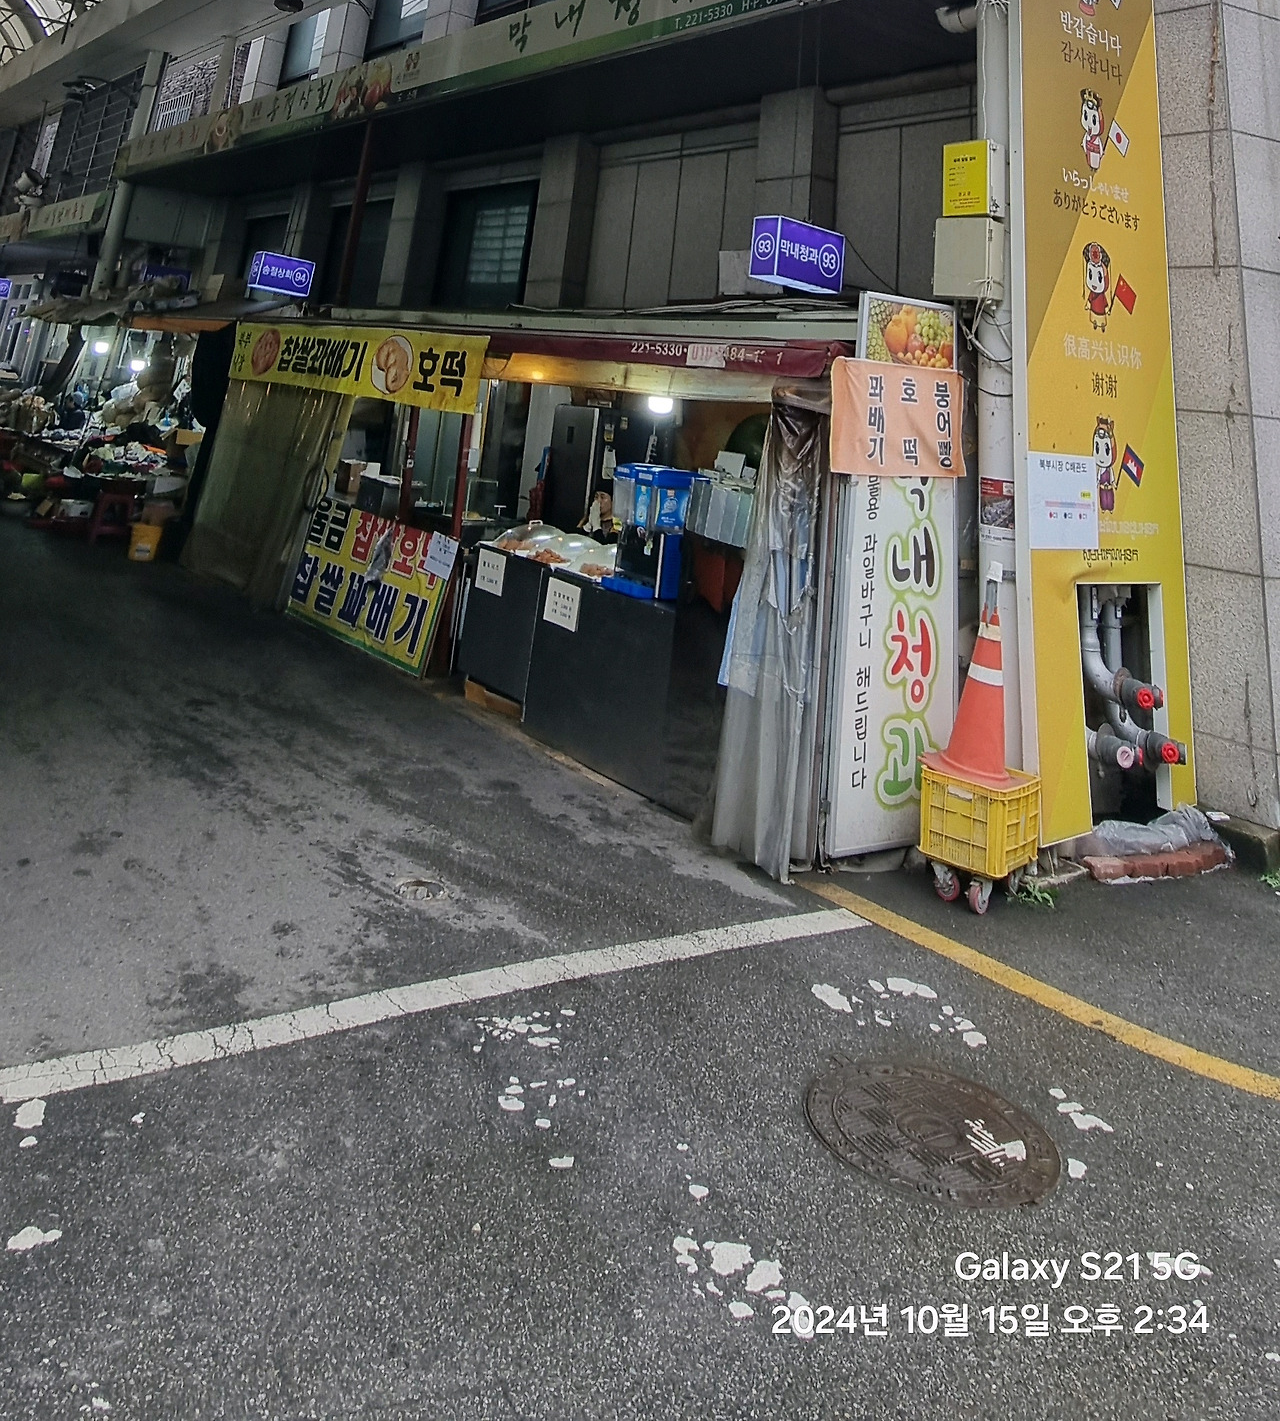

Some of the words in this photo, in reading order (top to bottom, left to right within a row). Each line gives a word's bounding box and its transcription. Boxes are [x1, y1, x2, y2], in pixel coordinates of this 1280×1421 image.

[686, 2, 733, 28] 221-5330
[1060, 10, 1121, 56] 반갑습니다
[1060, 40, 1122, 85] 감사합니다
[1062, 167, 1130, 204] いらっしゃいませ
[1053, 189, 1140, 232] ありがとうございます
[758, 240, 771, 253] 93
[781, 239, 818, 265] 막내청과
[822, 252, 836, 270] 93
[295, 271, 307, 283] 94
[412, 347, 468, 398] 호떡
[1063, 333, 1142, 370] 很高兴认识你
[1091, 371, 1118, 399] 谢谢
[901, 377, 918, 466] 호떡
[934, 381, 952, 468] 붕어빵
[859, 534, 878, 649] 과일바구니
[884, 476, 936, 797] 내청과
[851, 666, 871, 791] 해드립니다
